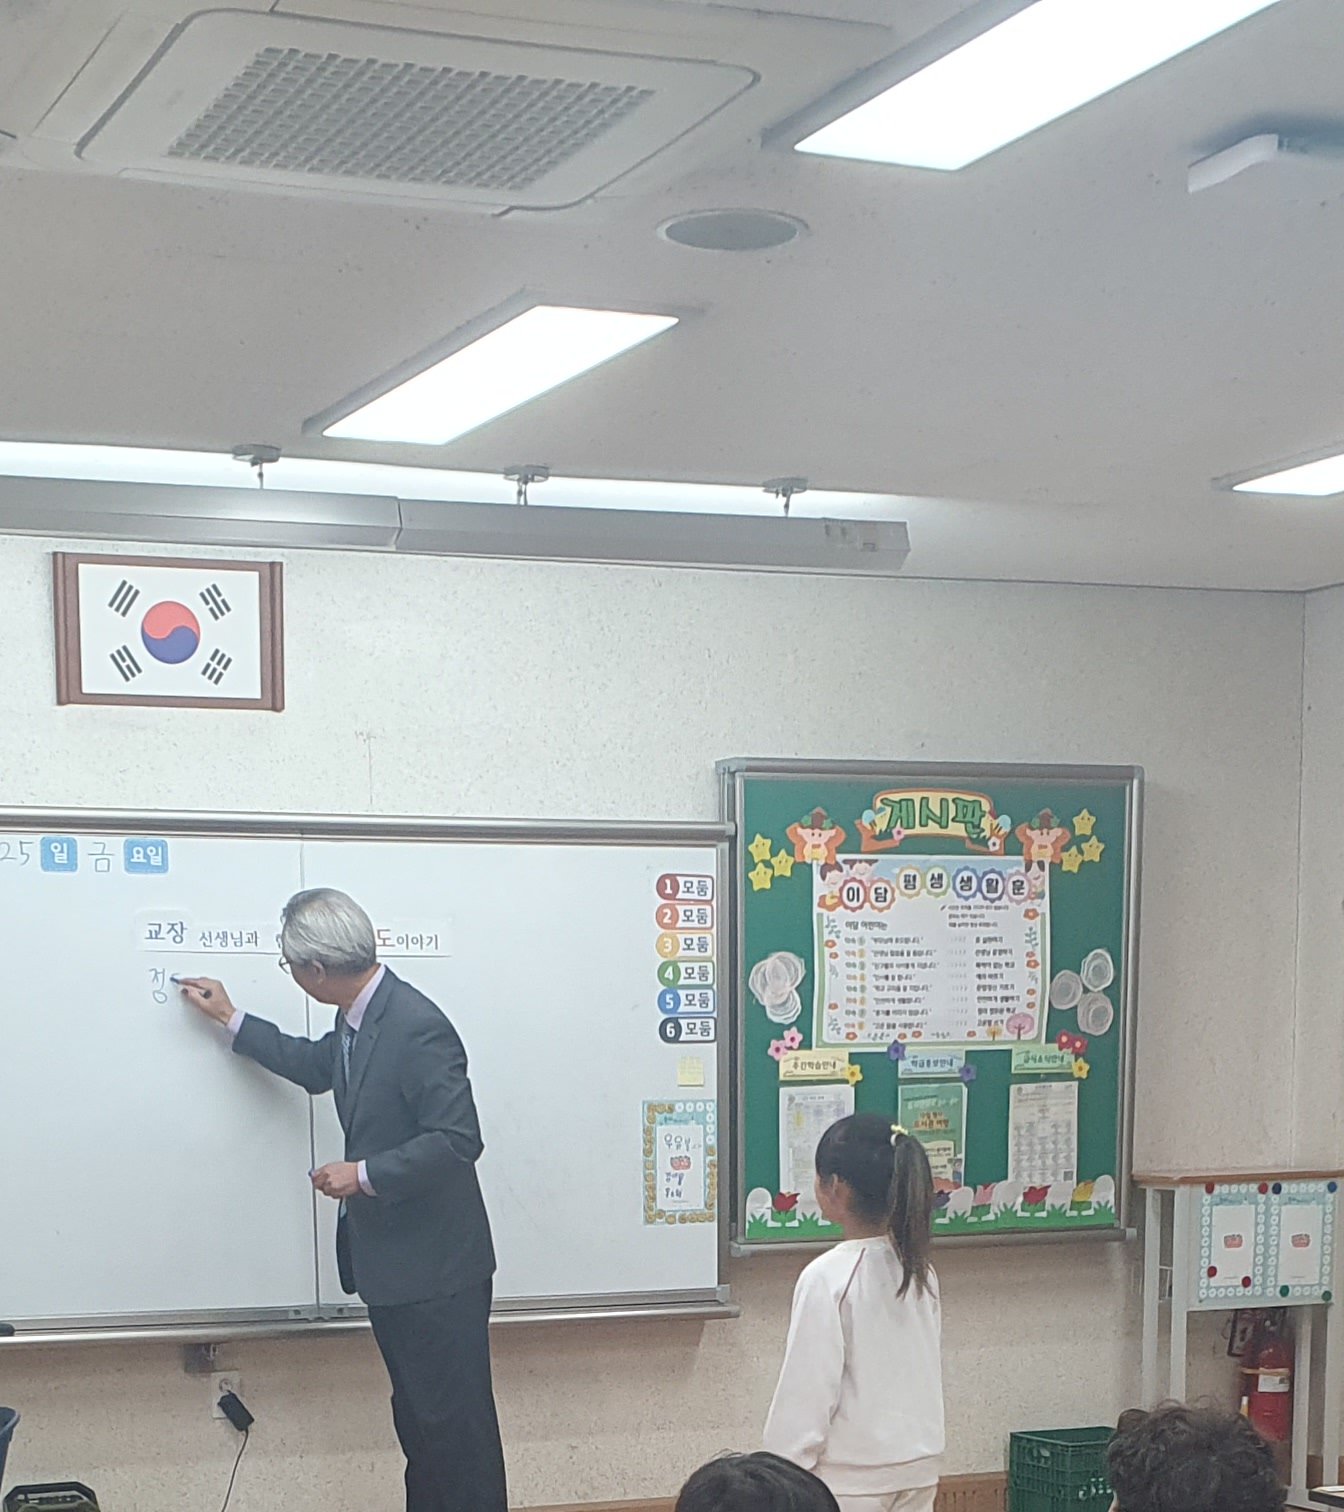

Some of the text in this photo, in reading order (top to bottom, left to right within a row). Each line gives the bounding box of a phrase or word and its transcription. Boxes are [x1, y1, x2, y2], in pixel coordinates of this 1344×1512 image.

[881, 797, 985, 839] 게시판
[0, 841, 34, 866] 25
[51, 841, 69, 864] 일
[88, 841, 116, 874] 금
[130, 844, 164, 867] 요일
[664, 879, 709, 897] 1 모둠
[846, 882, 890, 905] 이담
[902, 872, 945, 891] 평생
[662, 908, 709, 926] 2 모둠
[144, 920, 189, 945] 교장
[198, 930, 260, 949] 선생님과
[663, 937, 710, 954] 3 모둠
[664, 965, 710, 983] 4 모둠
[666, 992, 711, 1009] 5 모둠
[666, 1020, 712, 1039] 6 모둠
